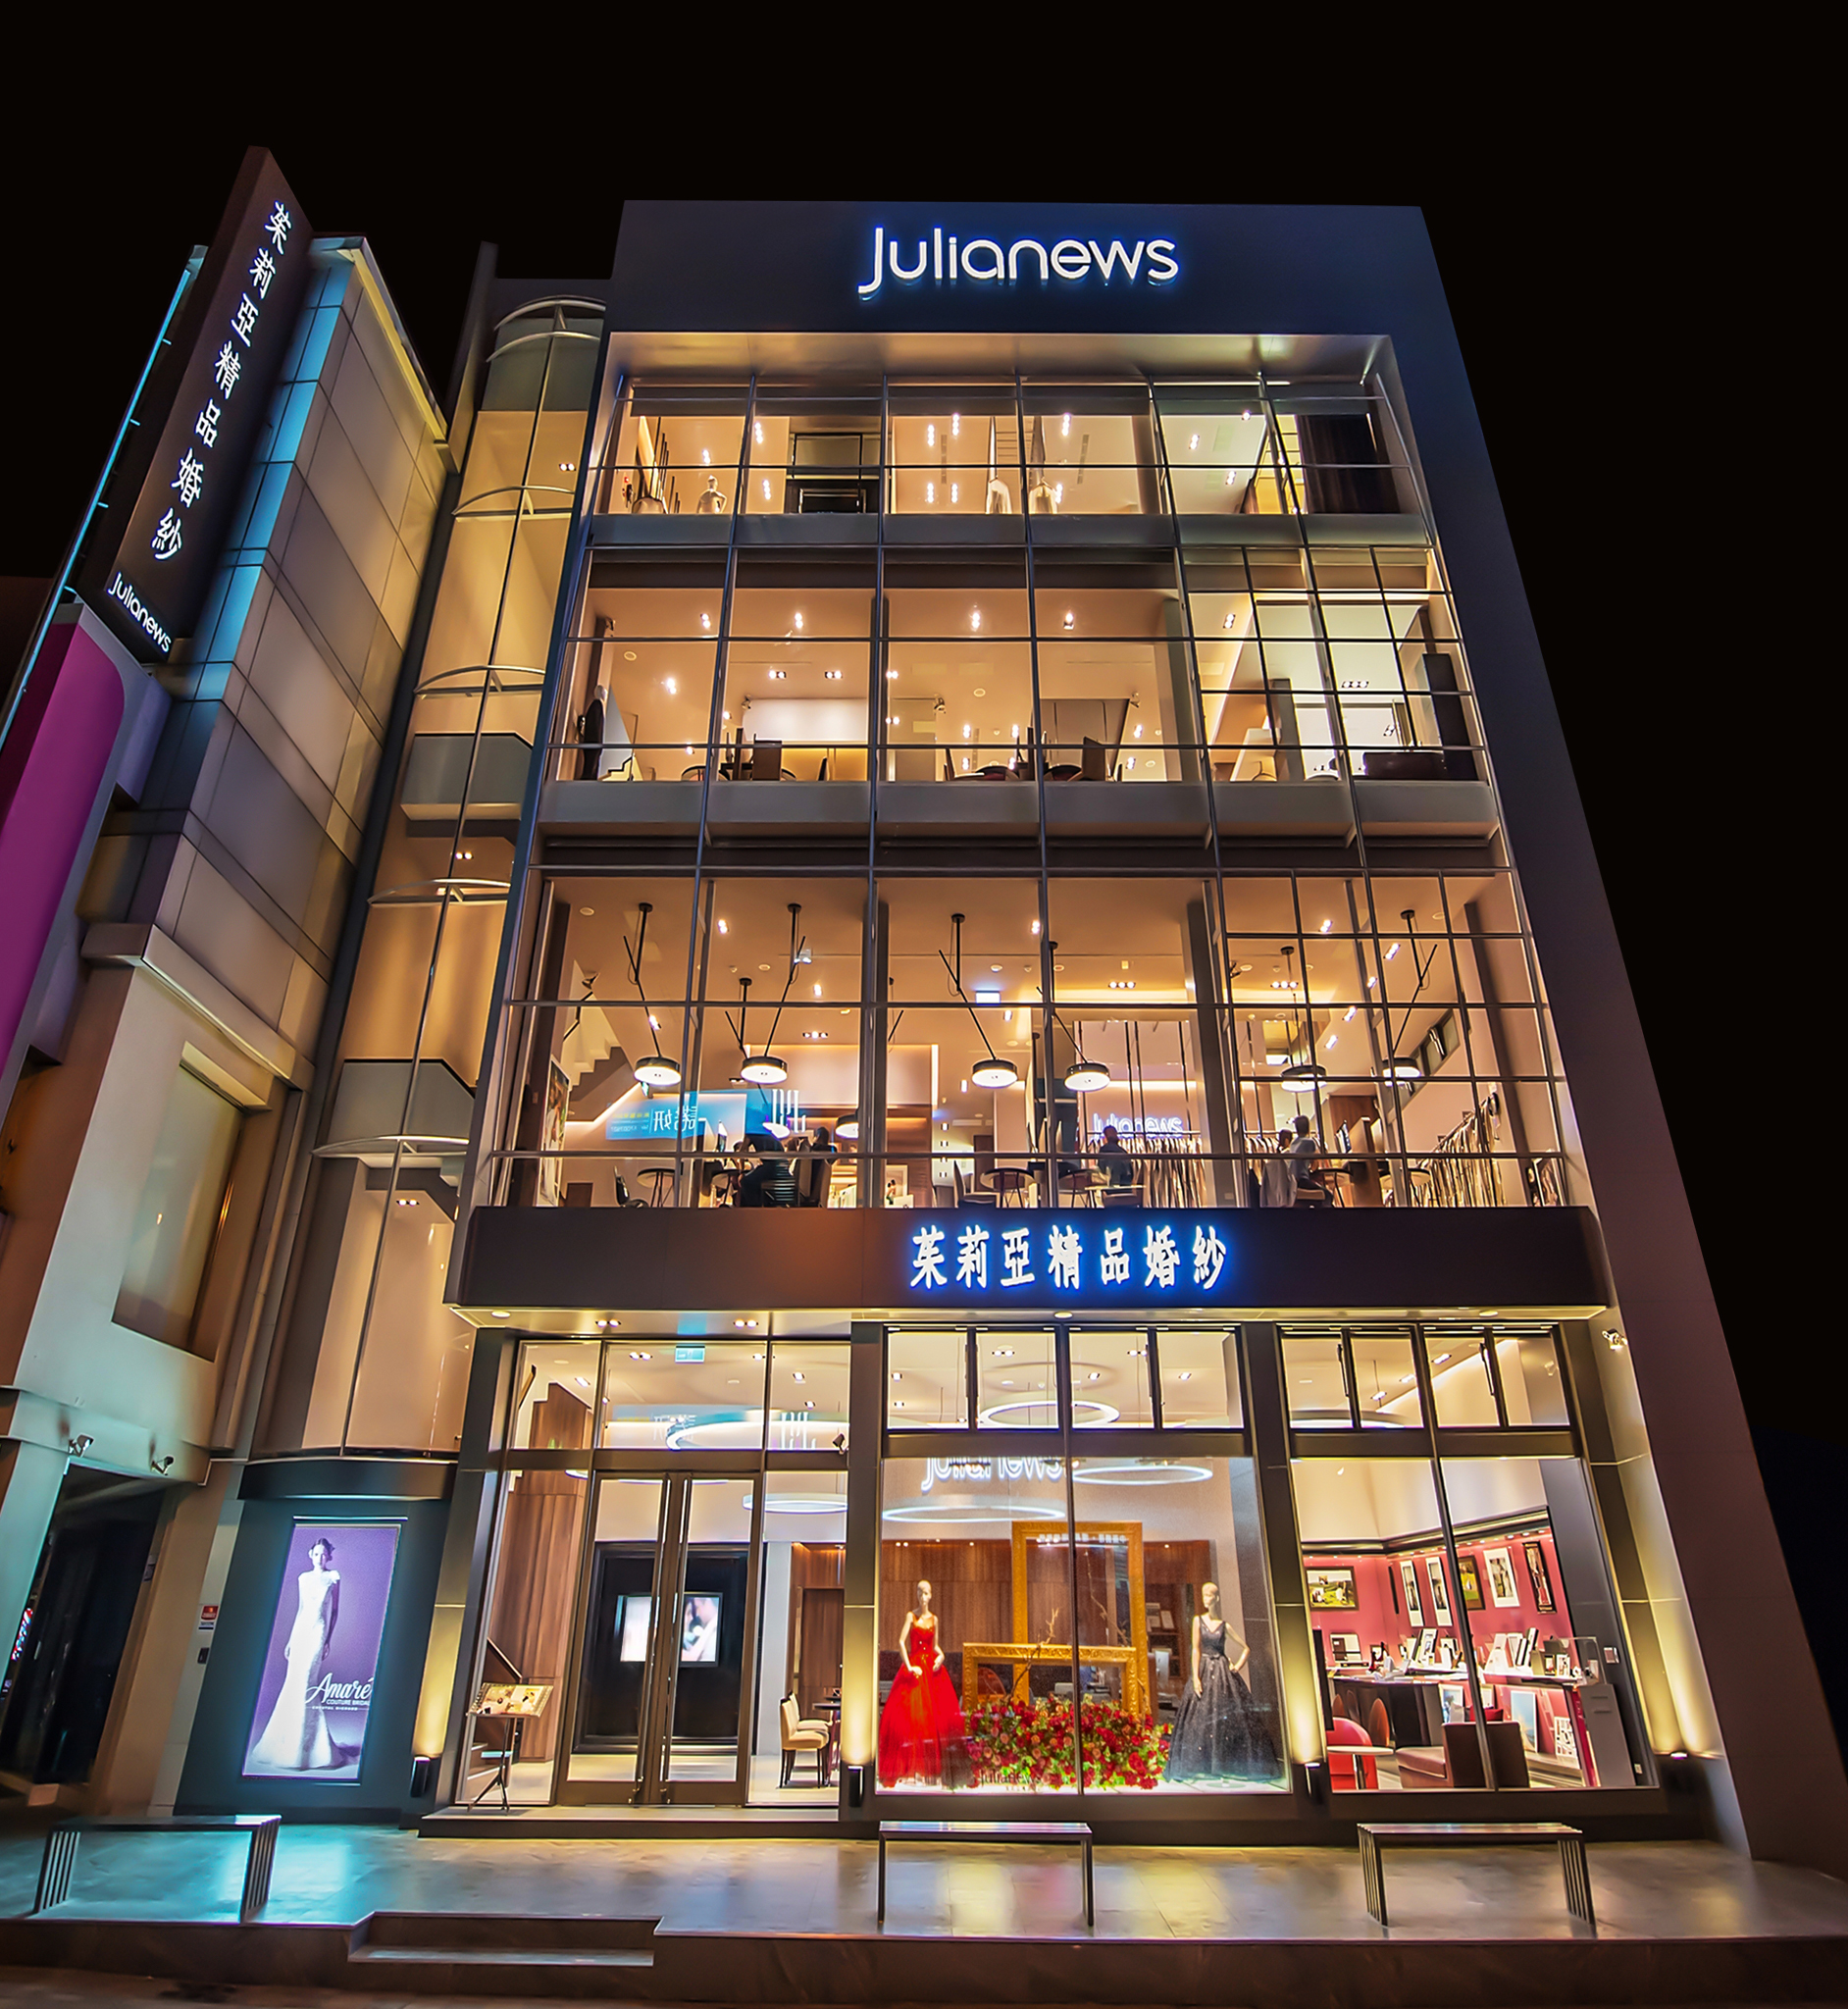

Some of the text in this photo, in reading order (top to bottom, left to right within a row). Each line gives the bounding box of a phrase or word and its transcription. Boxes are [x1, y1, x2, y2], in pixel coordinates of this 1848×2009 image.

[857, 227, 1179, 296] Julianews
[151, 201, 292, 560] 茱莉亞精品婚紗
[107, 571, 172, 653] Julianews
[910, 1224, 1227, 1290] 茱莉亞精品婚紗
[305, 1672, 374, 1704] Amaré
